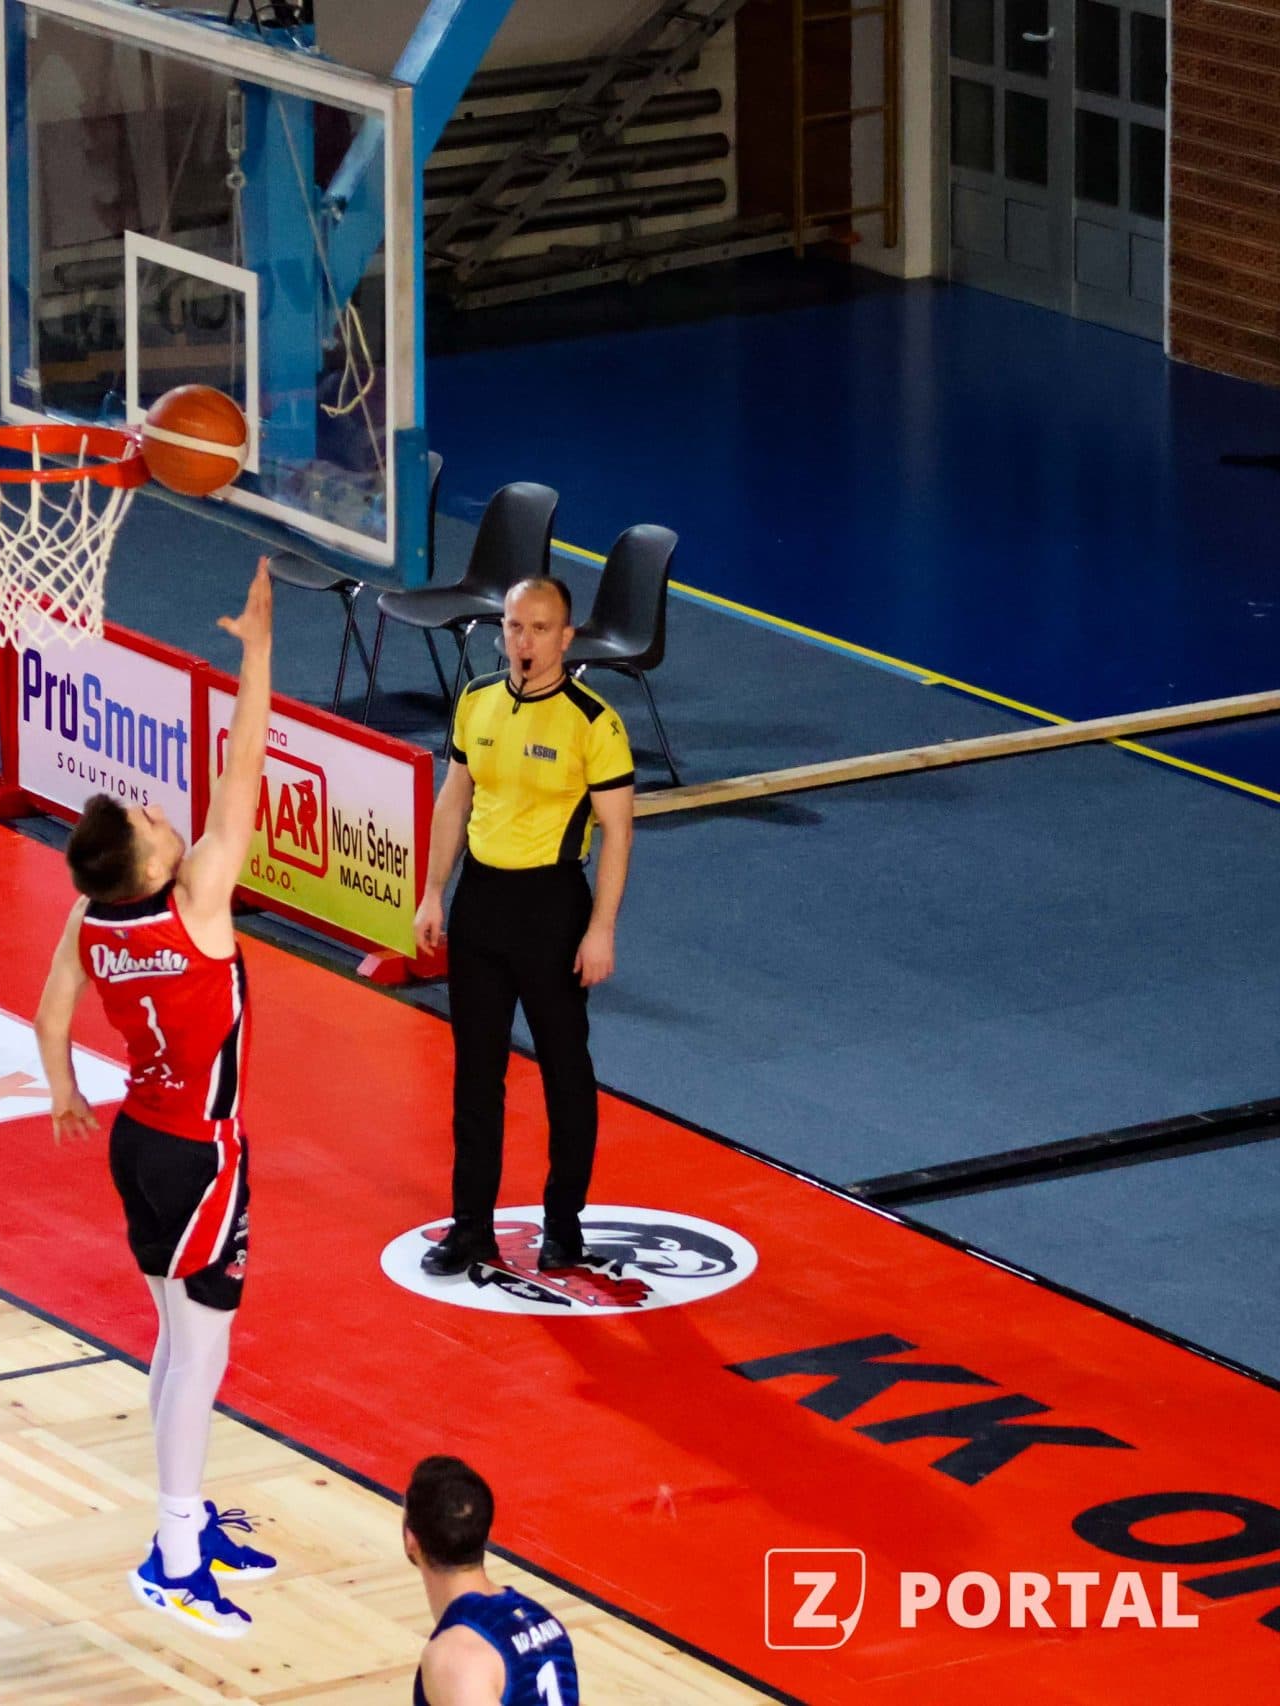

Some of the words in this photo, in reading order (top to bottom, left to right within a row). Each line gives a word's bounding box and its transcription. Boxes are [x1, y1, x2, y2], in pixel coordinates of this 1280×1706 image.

[22, 648, 188, 792] ProSmart
[57, 752, 149, 806] SOLUTIONS
[250, 854, 297, 892] d.o.o.
[331, 806, 363, 862] Novi
[367, 808, 409, 880] Šeher
[339, 865, 401, 908] MAGLAJ
[723, 1332, 1139, 1488] KK
